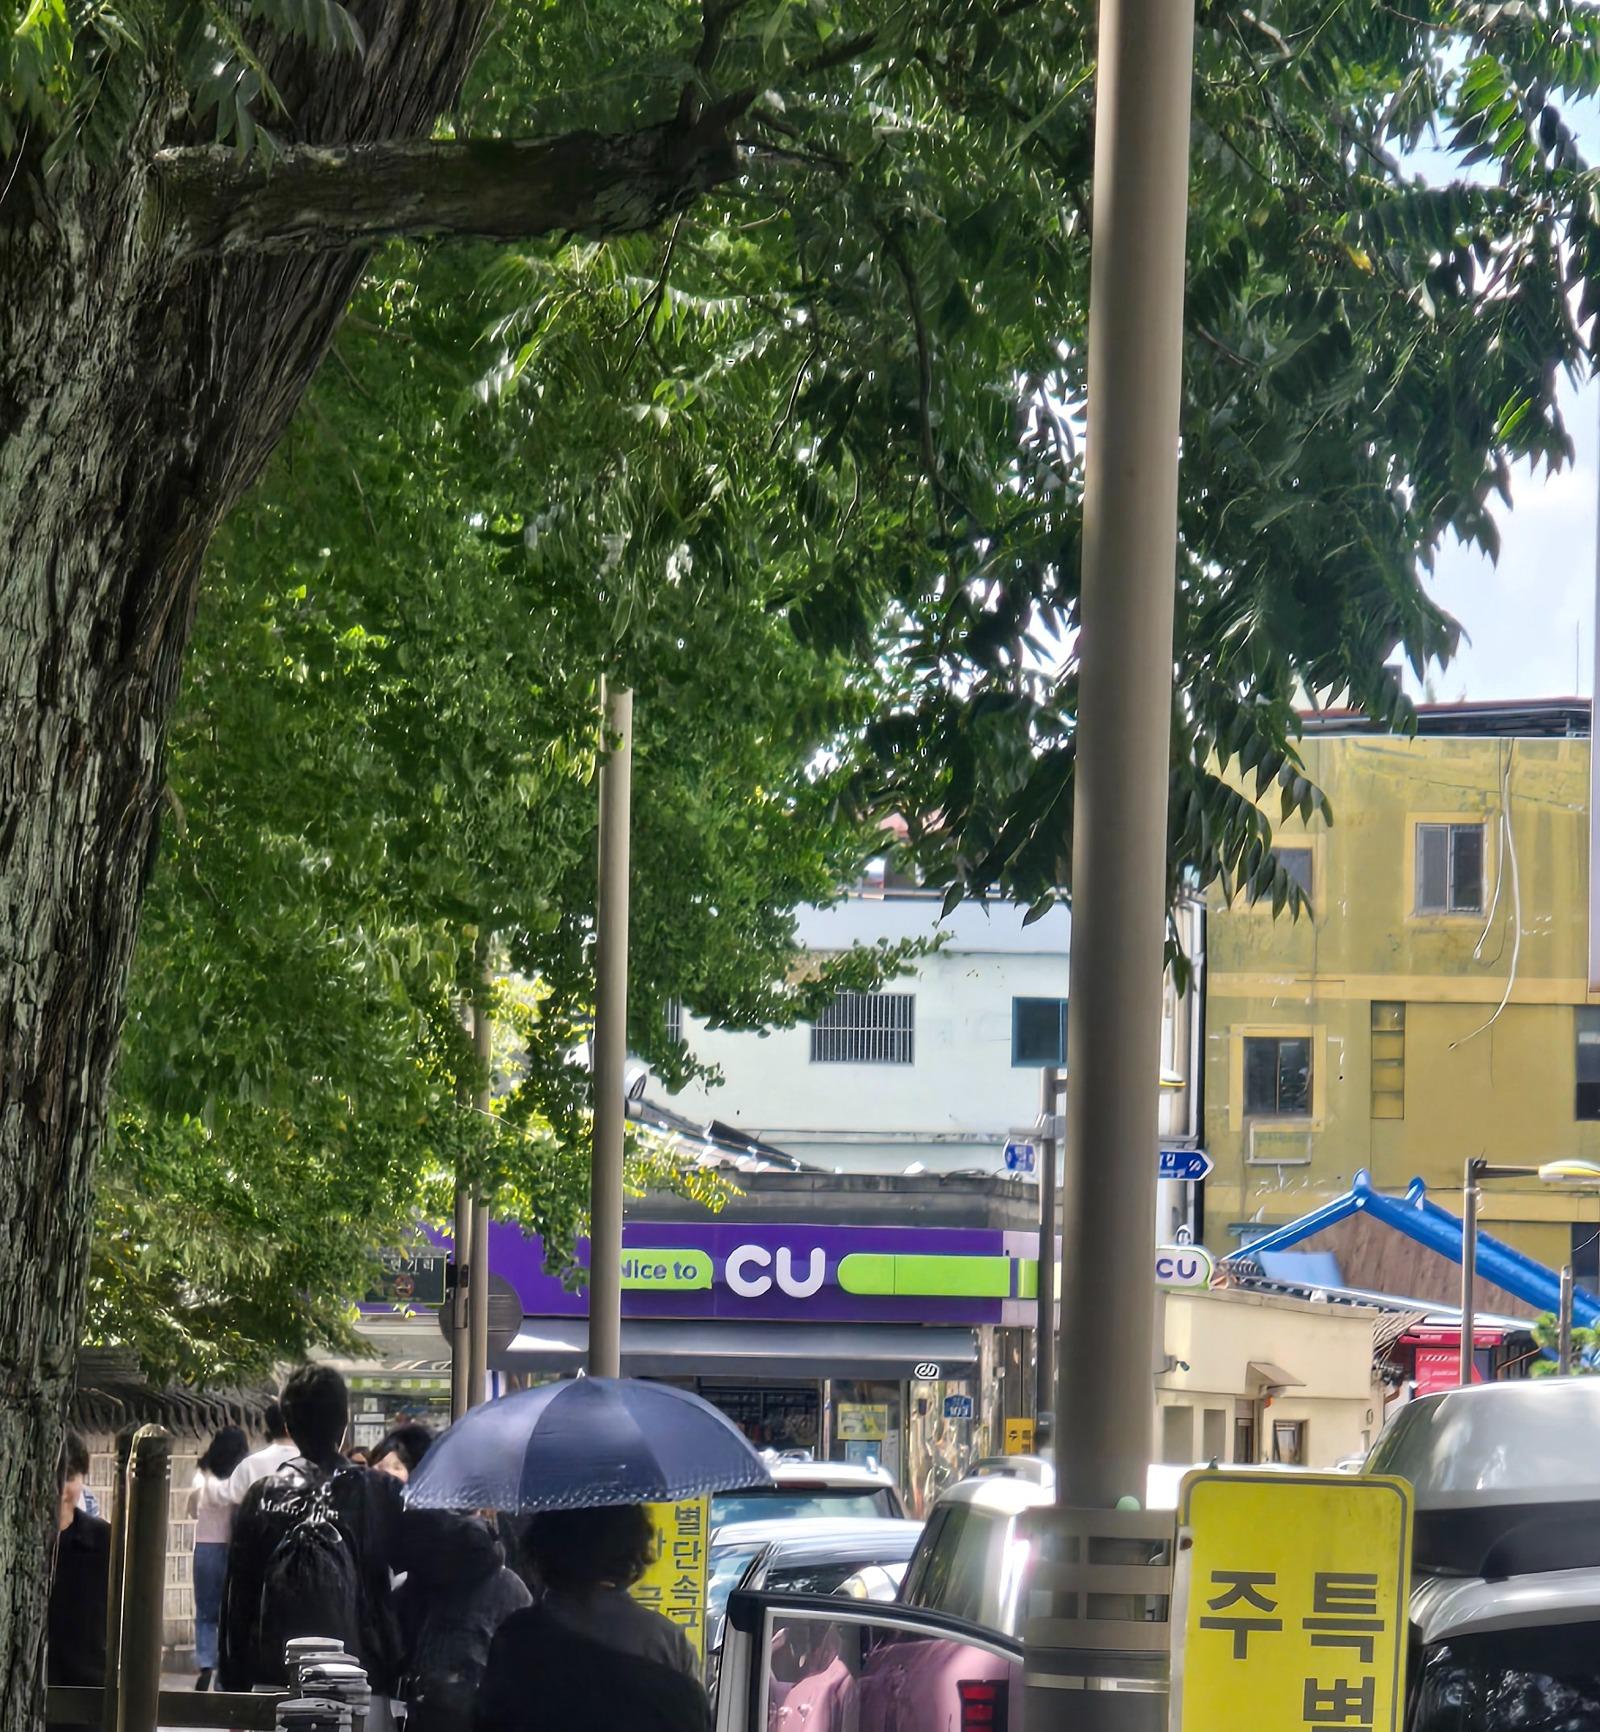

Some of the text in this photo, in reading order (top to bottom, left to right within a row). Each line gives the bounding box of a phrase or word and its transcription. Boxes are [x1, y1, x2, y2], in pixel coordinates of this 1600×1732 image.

[622, 1244, 826, 1298] Nice to CU
[1156, 1258, 1197, 1279] CU
